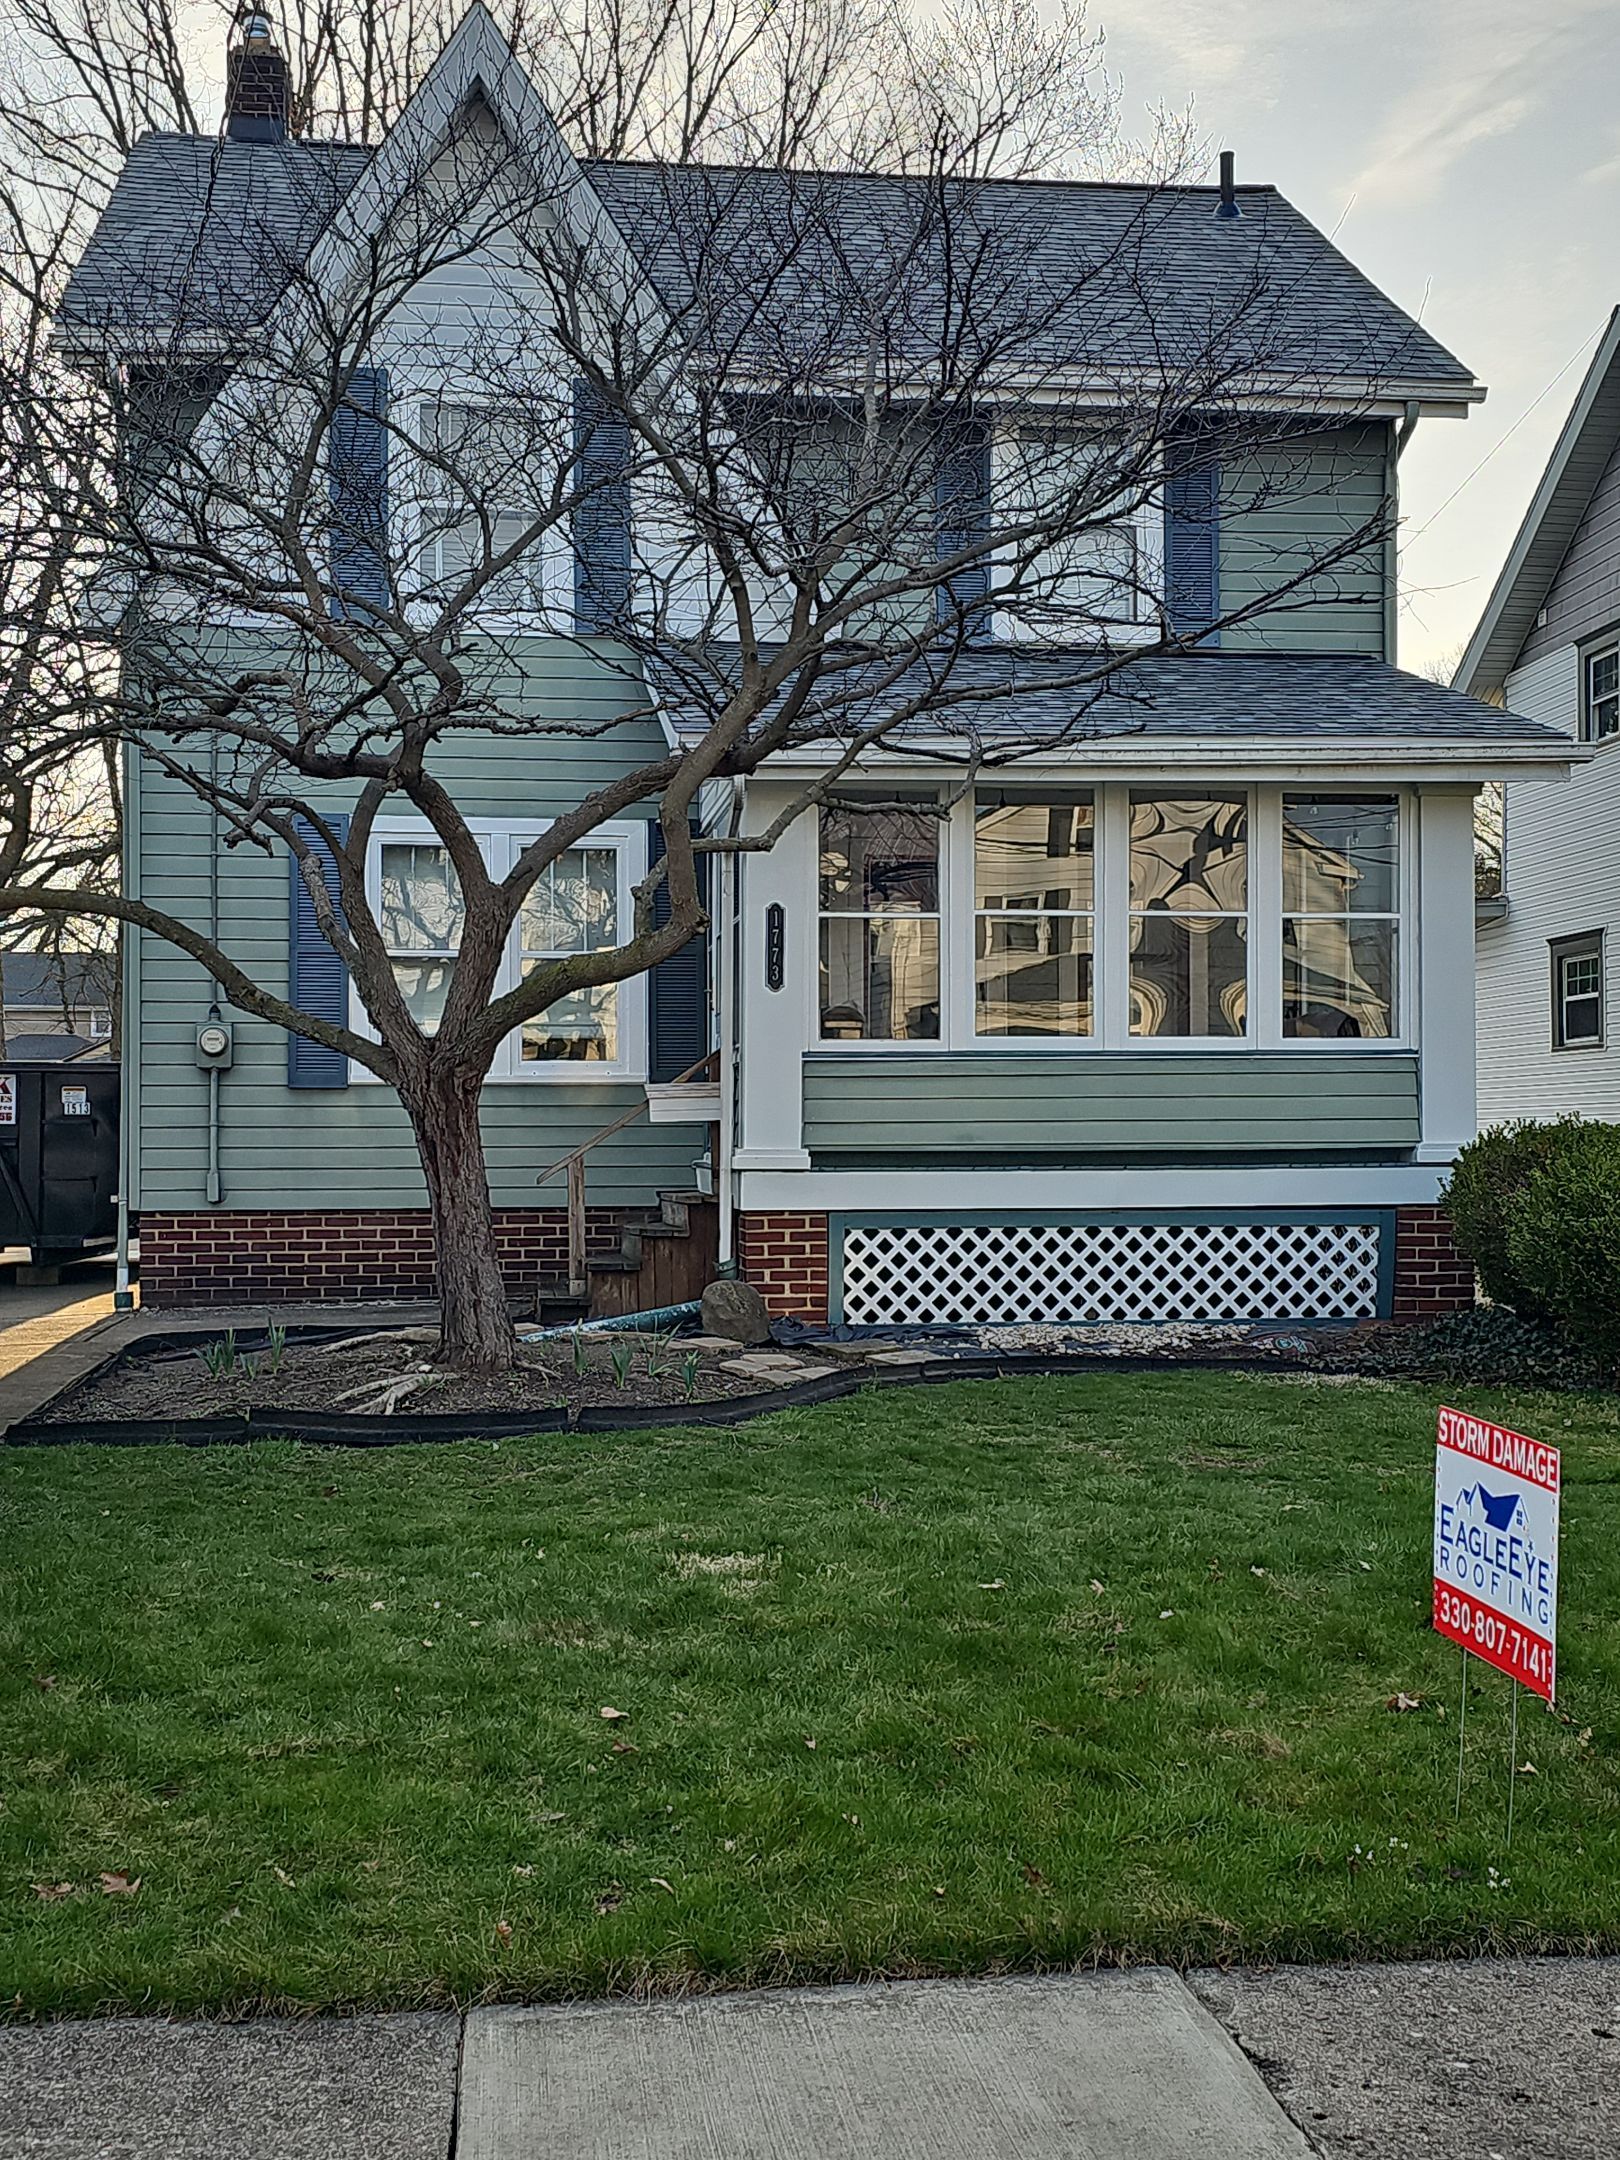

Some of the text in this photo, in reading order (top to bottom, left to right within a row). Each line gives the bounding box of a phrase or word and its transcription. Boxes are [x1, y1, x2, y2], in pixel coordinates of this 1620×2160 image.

[771, 910, 780, 981] 1773
[66, 1103, 89, 1114] 1513
[1438, 1410, 1557, 1488] STORM DAMAGE
[1440, 1546, 1550, 1625] ROOFING
[1440, 1591, 1548, 1683] 330-807-7141
